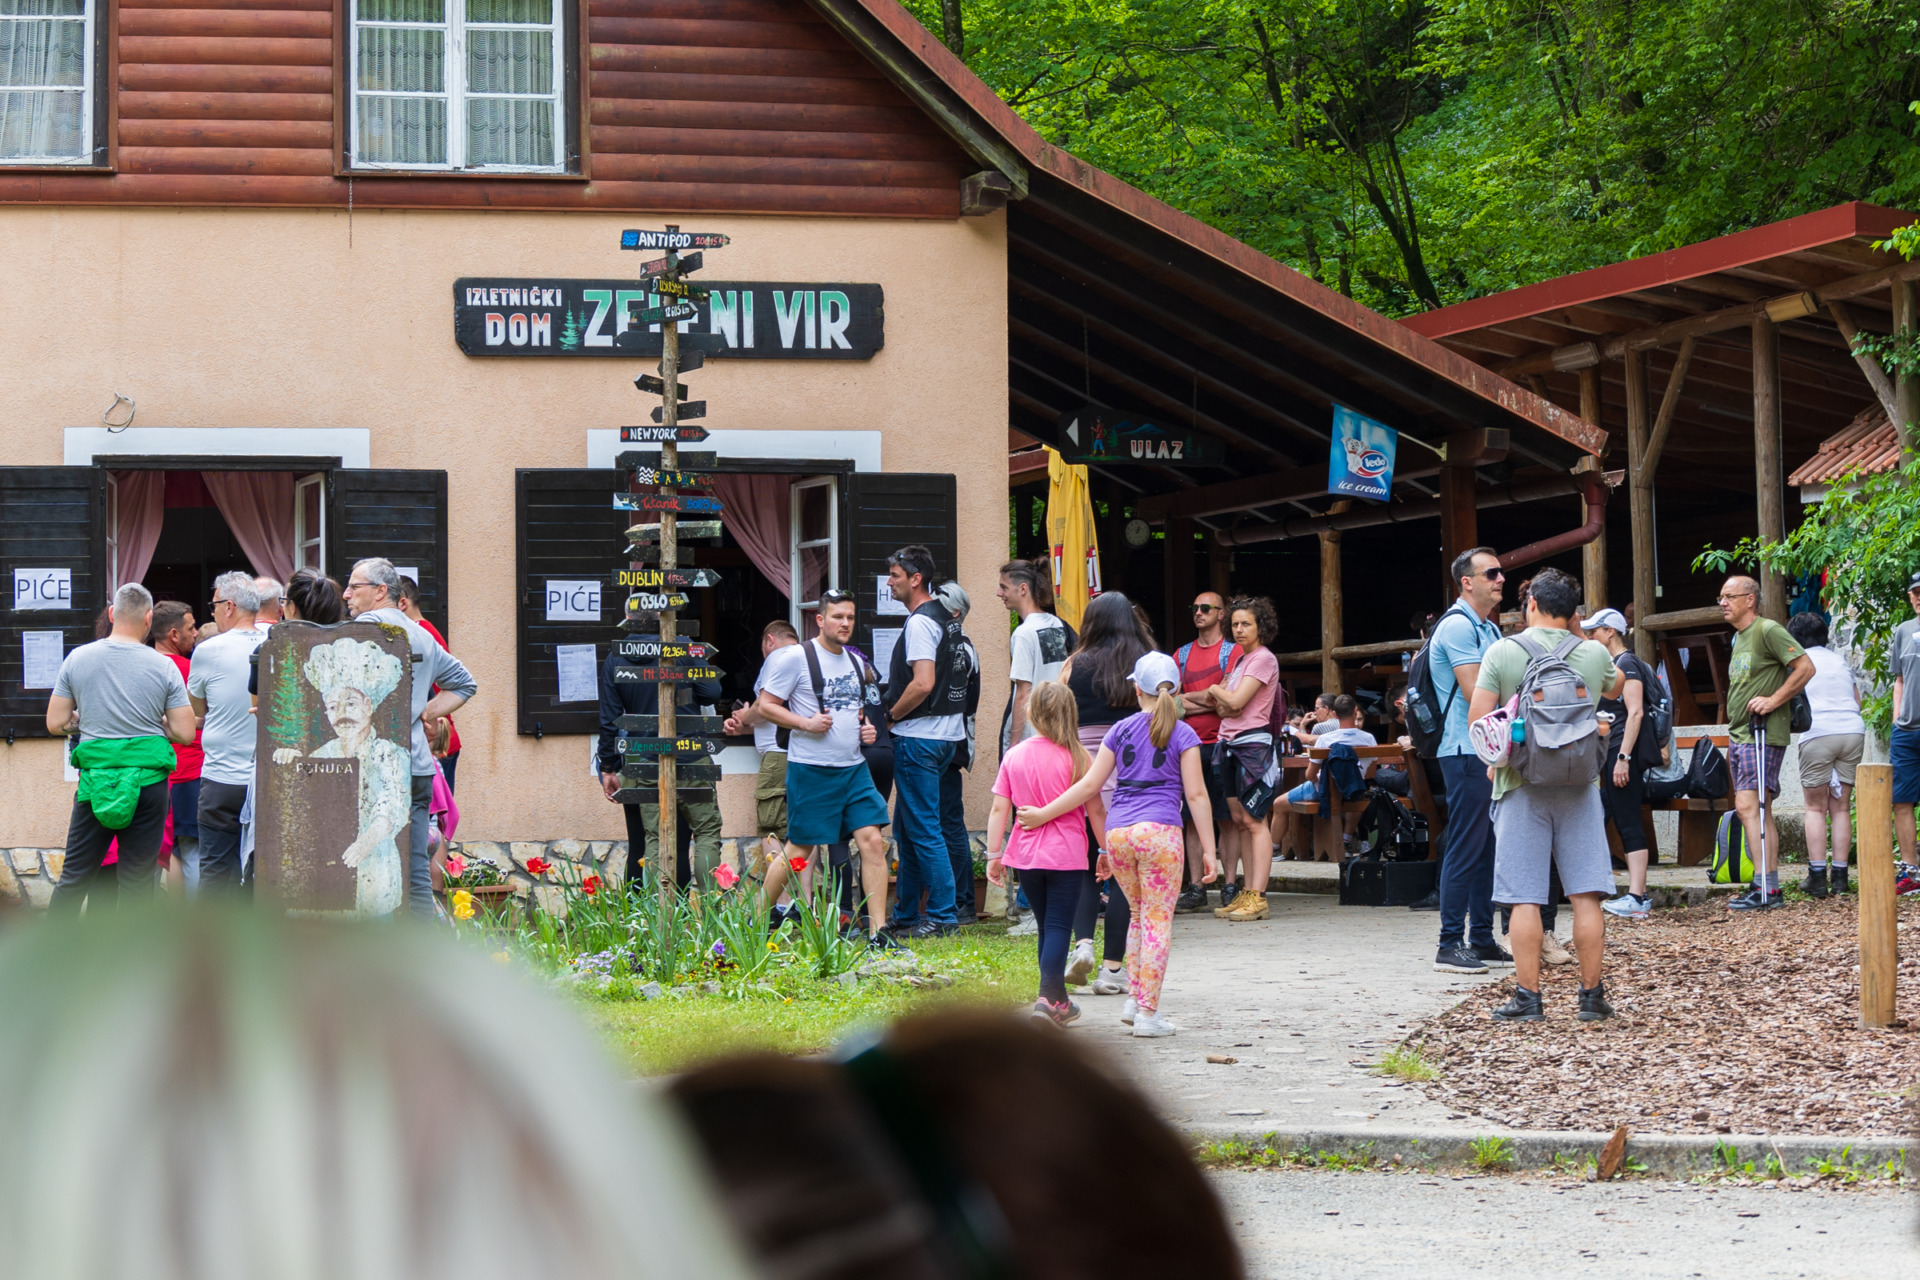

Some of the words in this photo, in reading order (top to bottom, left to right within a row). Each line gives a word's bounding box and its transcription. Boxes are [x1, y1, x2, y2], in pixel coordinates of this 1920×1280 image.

[639, 232, 691, 248] ANTIPOD
[466, 286, 562, 307] IZLETNIČKI
[772, 290, 853, 349] VIR
[485, 312, 551, 346] DOM
[1130, 439, 1183, 460] ULAZ
[1364, 456, 1386, 468] ledo
[1354, 483, 1388, 496] cream
[17, 573, 70, 600] PIĆE
[548, 585, 600, 612] PIĆE
[640, 594, 668, 610] OSLO
[619, 642, 661, 655] LONDON
[660, 667, 684, 680] Blanc
[688, 668, 703, 678] 621
[705, 667, 716, 678] km
[630, 740, 672, 755] Venecija
[691, 740, 702, 751] km
